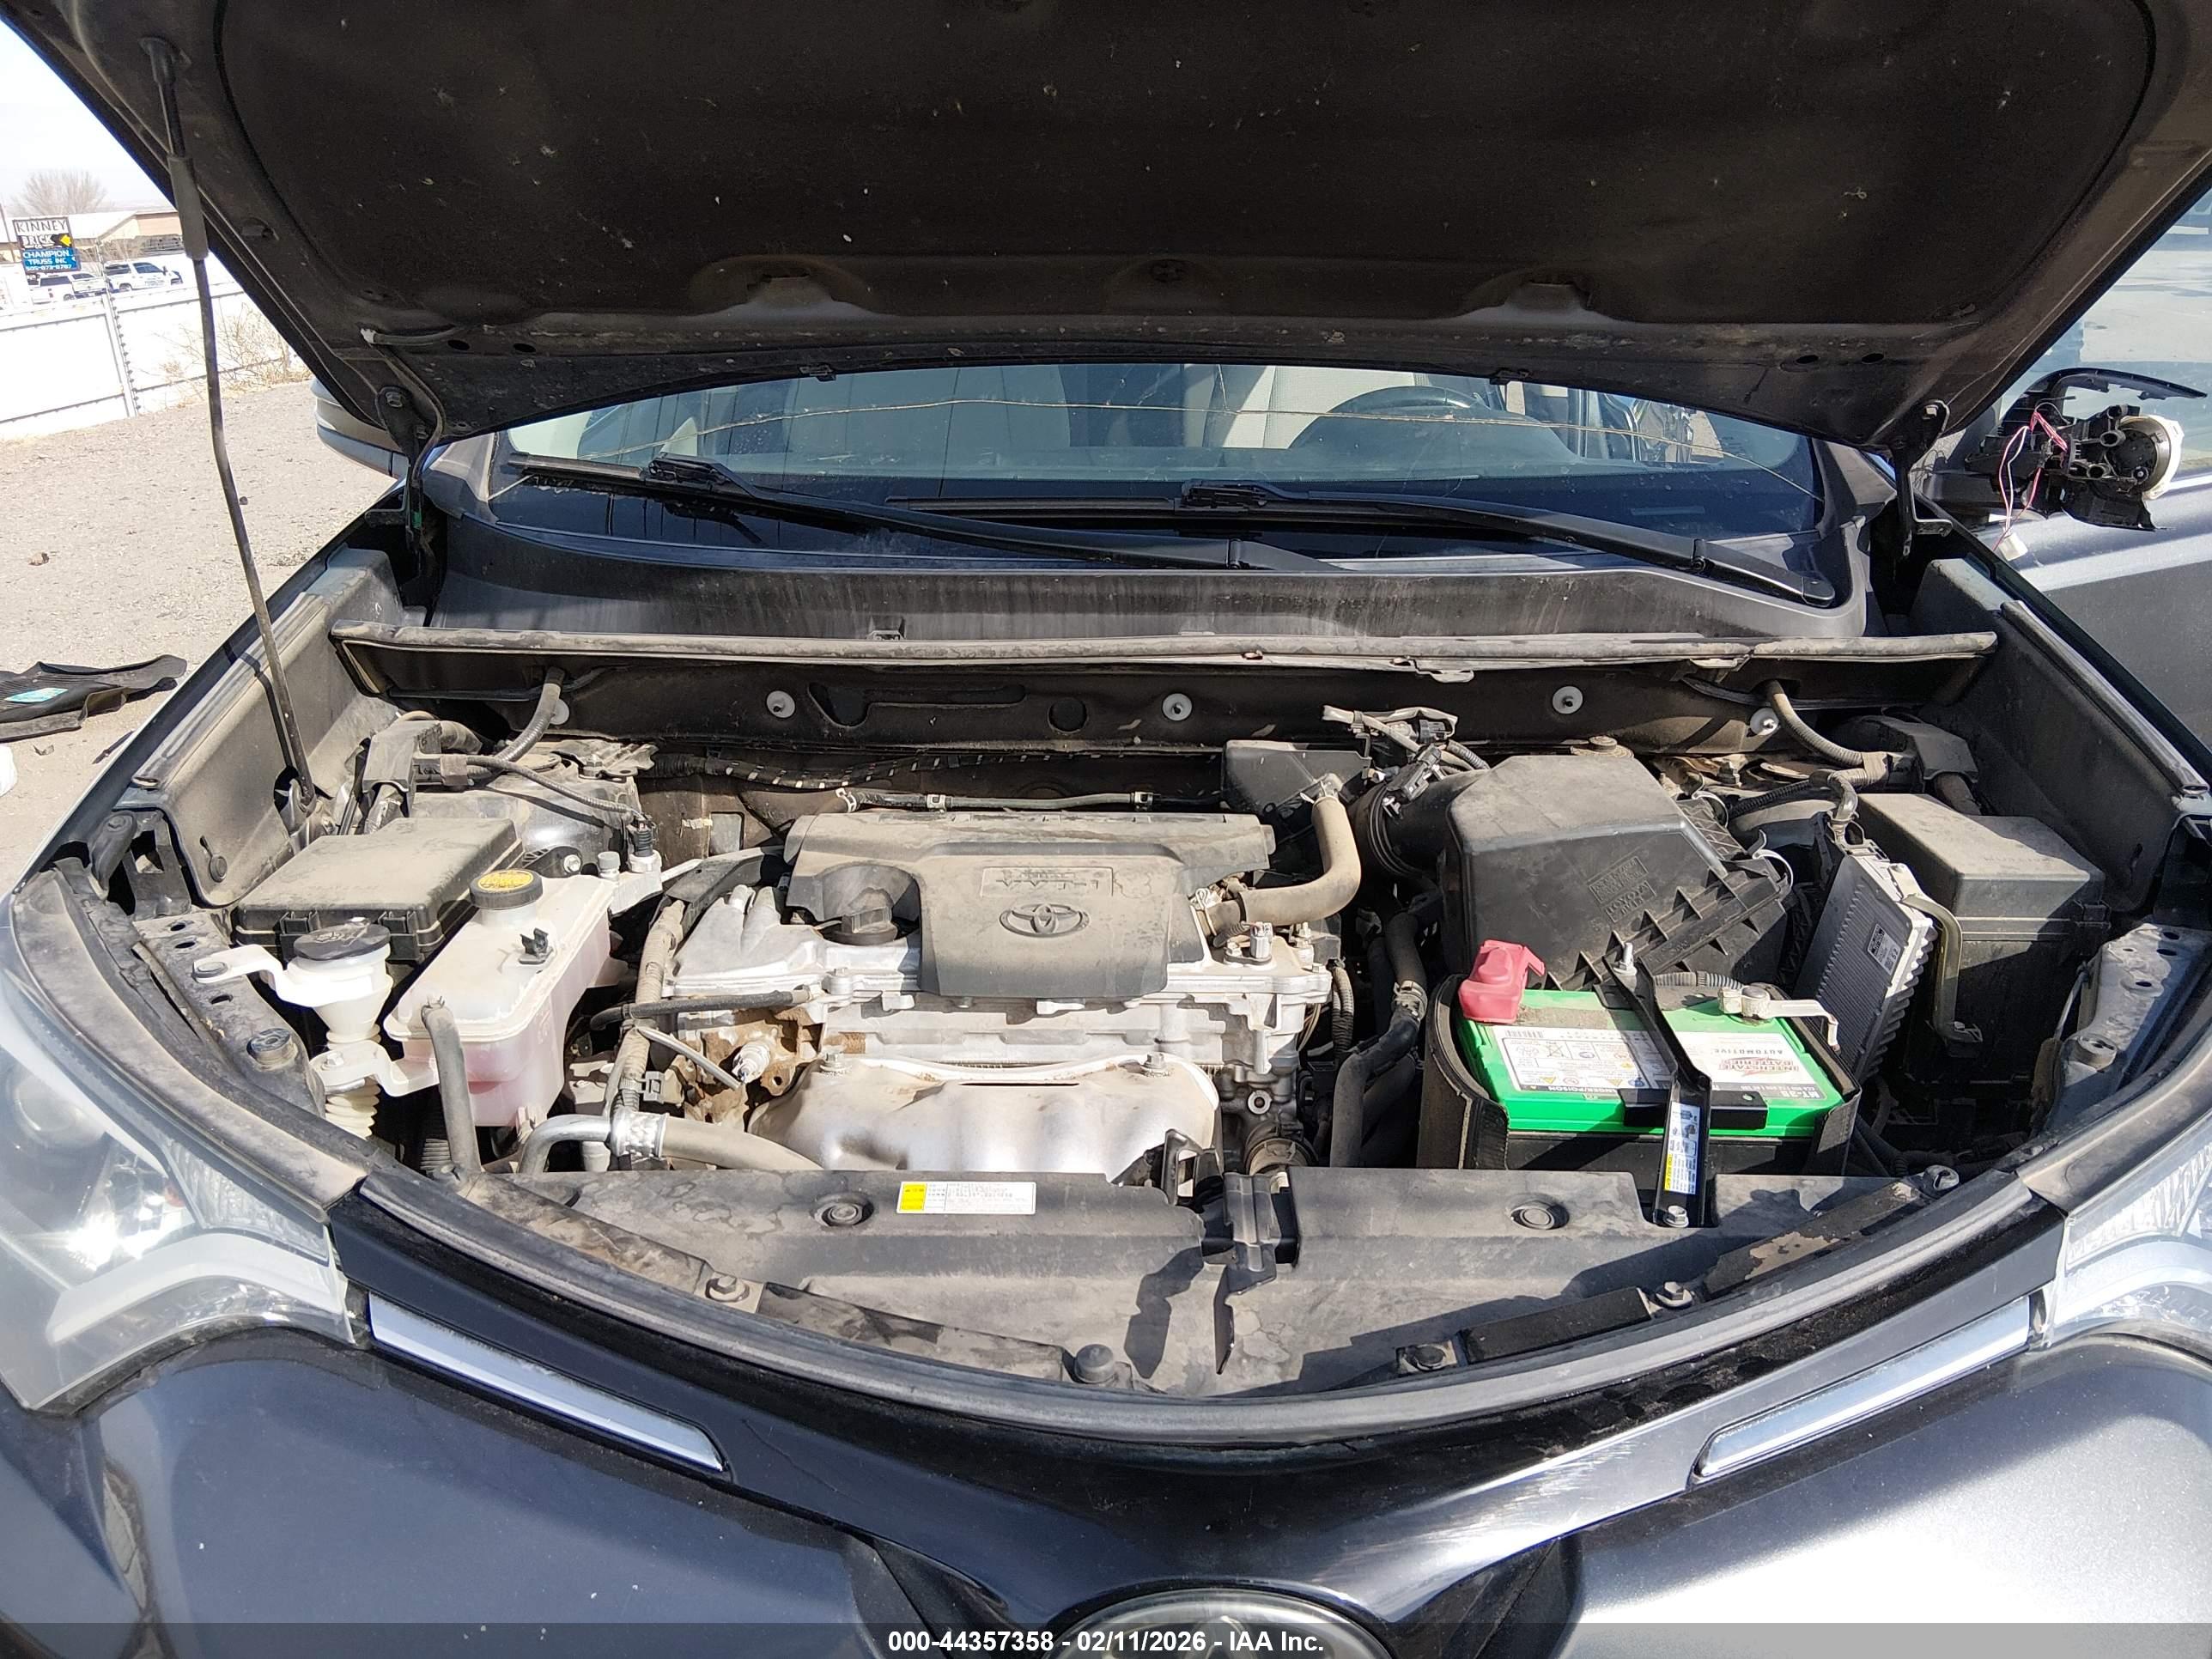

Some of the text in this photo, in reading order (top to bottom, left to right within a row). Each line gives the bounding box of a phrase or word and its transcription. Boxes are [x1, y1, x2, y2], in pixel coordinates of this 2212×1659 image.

[17, 220, 66, 232] KINNEY
[22, 236, 55, 245] BRICK
[23, 250, 70, 258] CHAMPION
